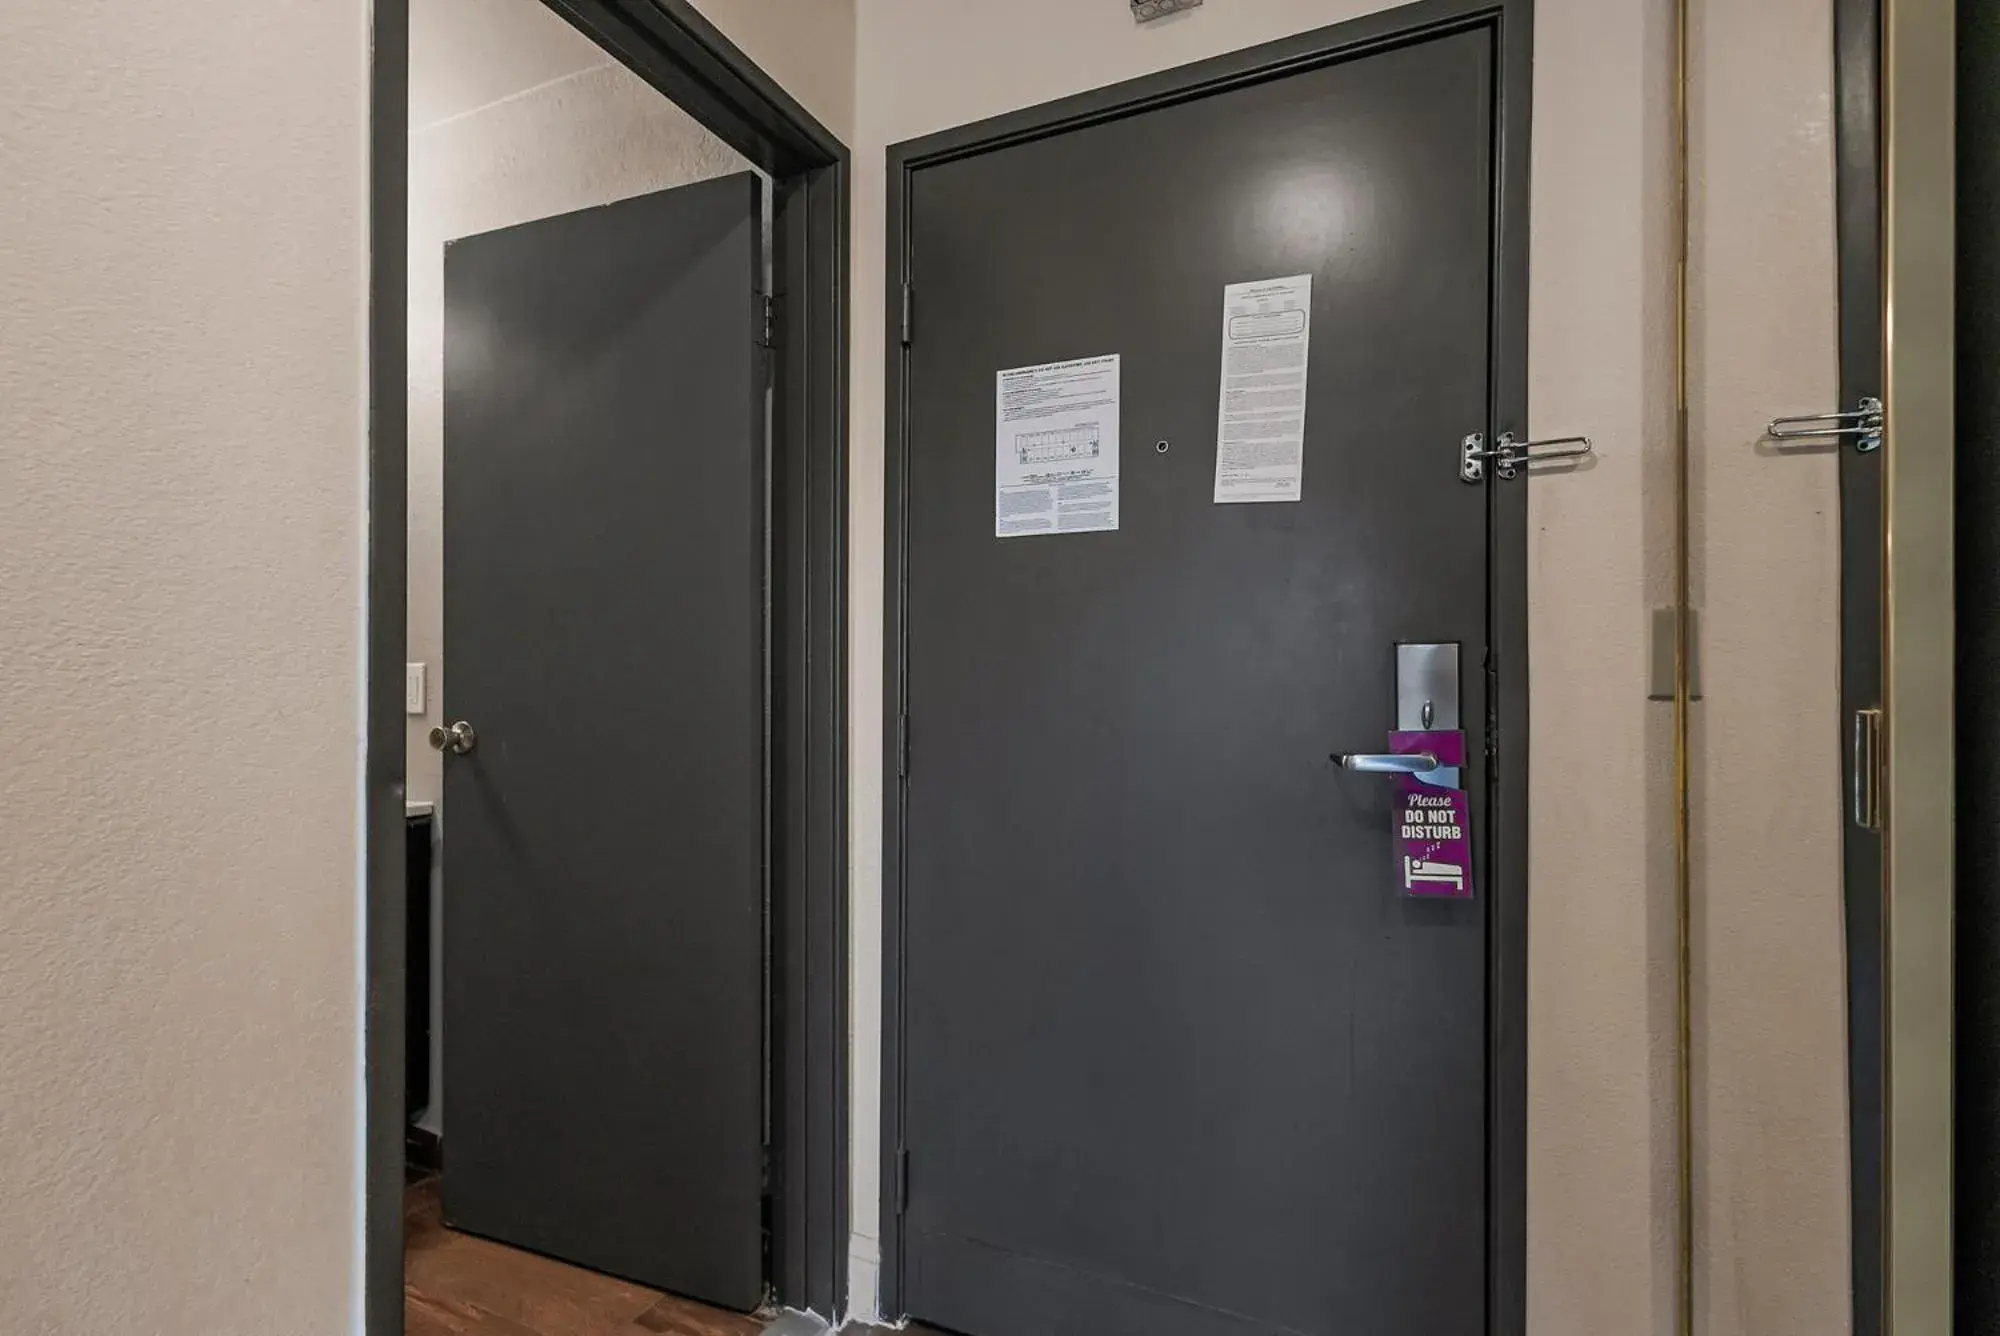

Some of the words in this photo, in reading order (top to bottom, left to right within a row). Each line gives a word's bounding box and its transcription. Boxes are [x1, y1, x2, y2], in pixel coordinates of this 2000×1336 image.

[1408, 793, 1452, 806] Please
[1404, 809, 1424, 823] DO
[1427, 810, 1456, 823] NOT
[1401, 825, 1461, 839] DISTURB
